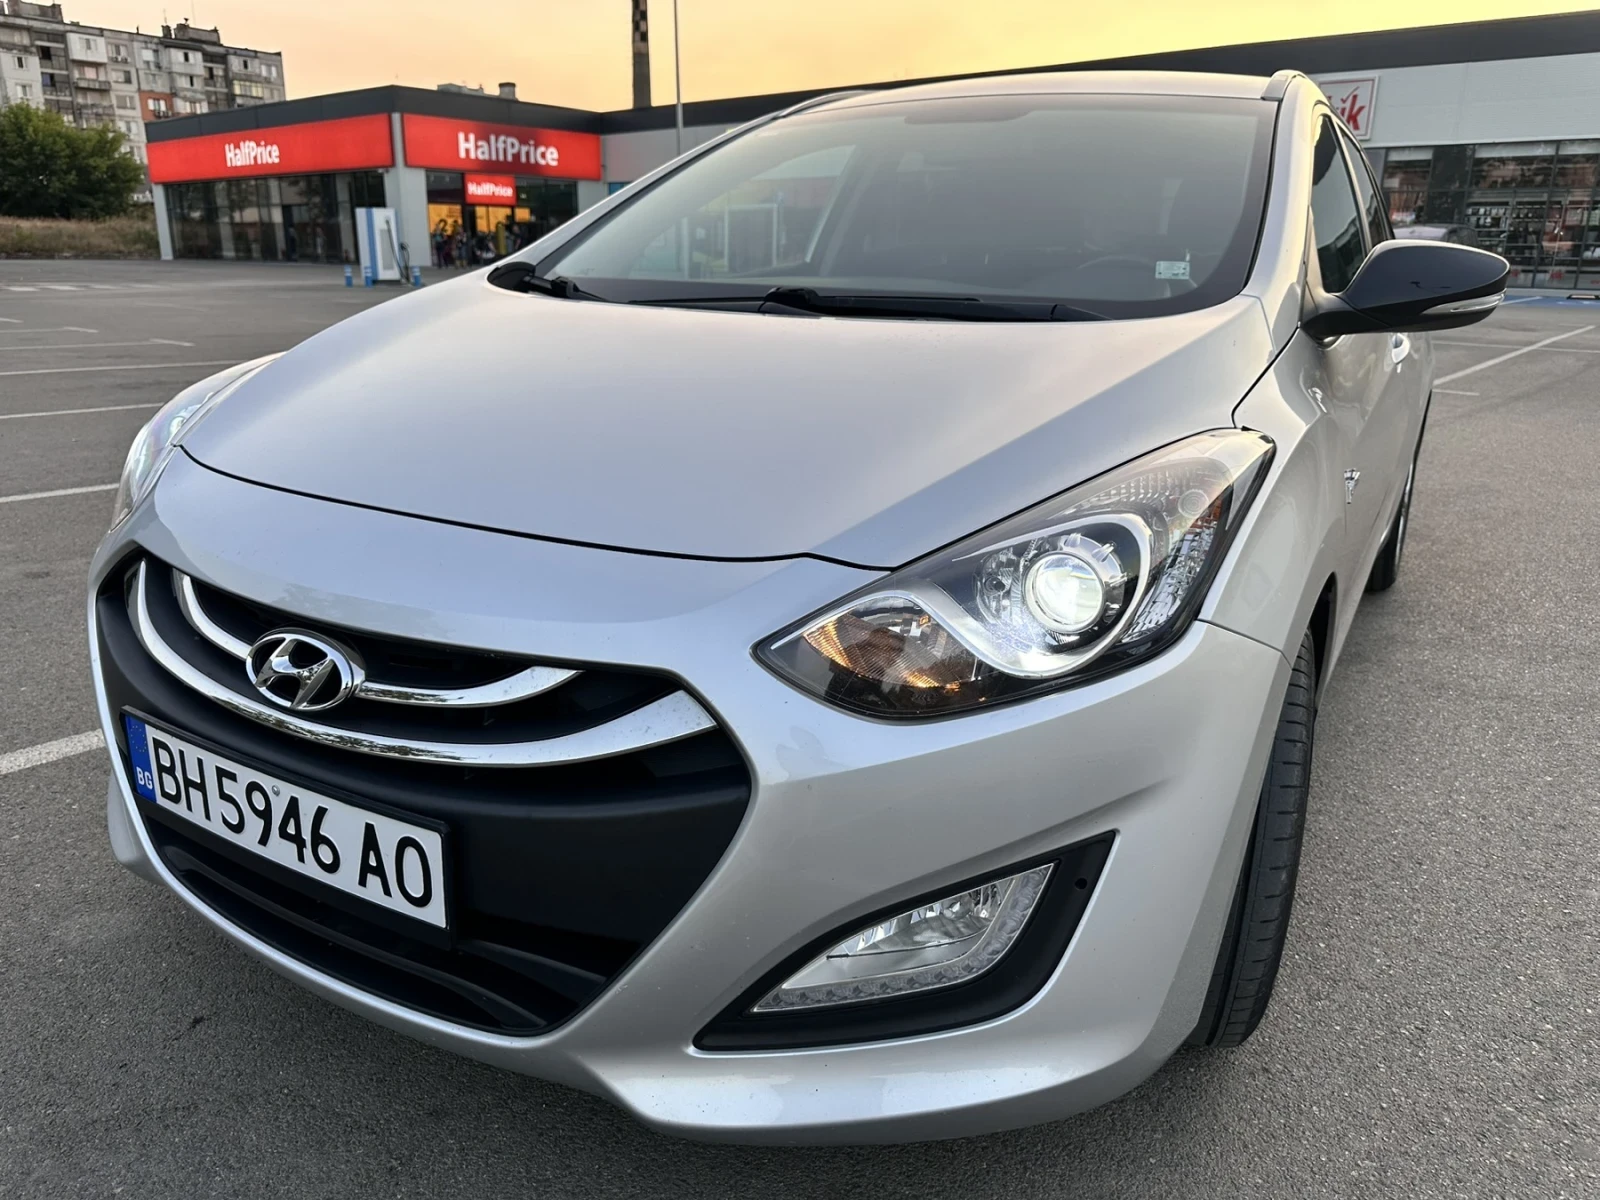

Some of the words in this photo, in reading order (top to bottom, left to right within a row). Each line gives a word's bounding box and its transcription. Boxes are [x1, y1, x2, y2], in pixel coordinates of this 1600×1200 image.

[225, 140, 280, 167] HalfPrice
[457, 132, 559, 167] HalfPrice
[467, 181, 514, 197] HalfPrice
[136, 766, 153, 790] BG
[357, 821, 433, 908] AO
